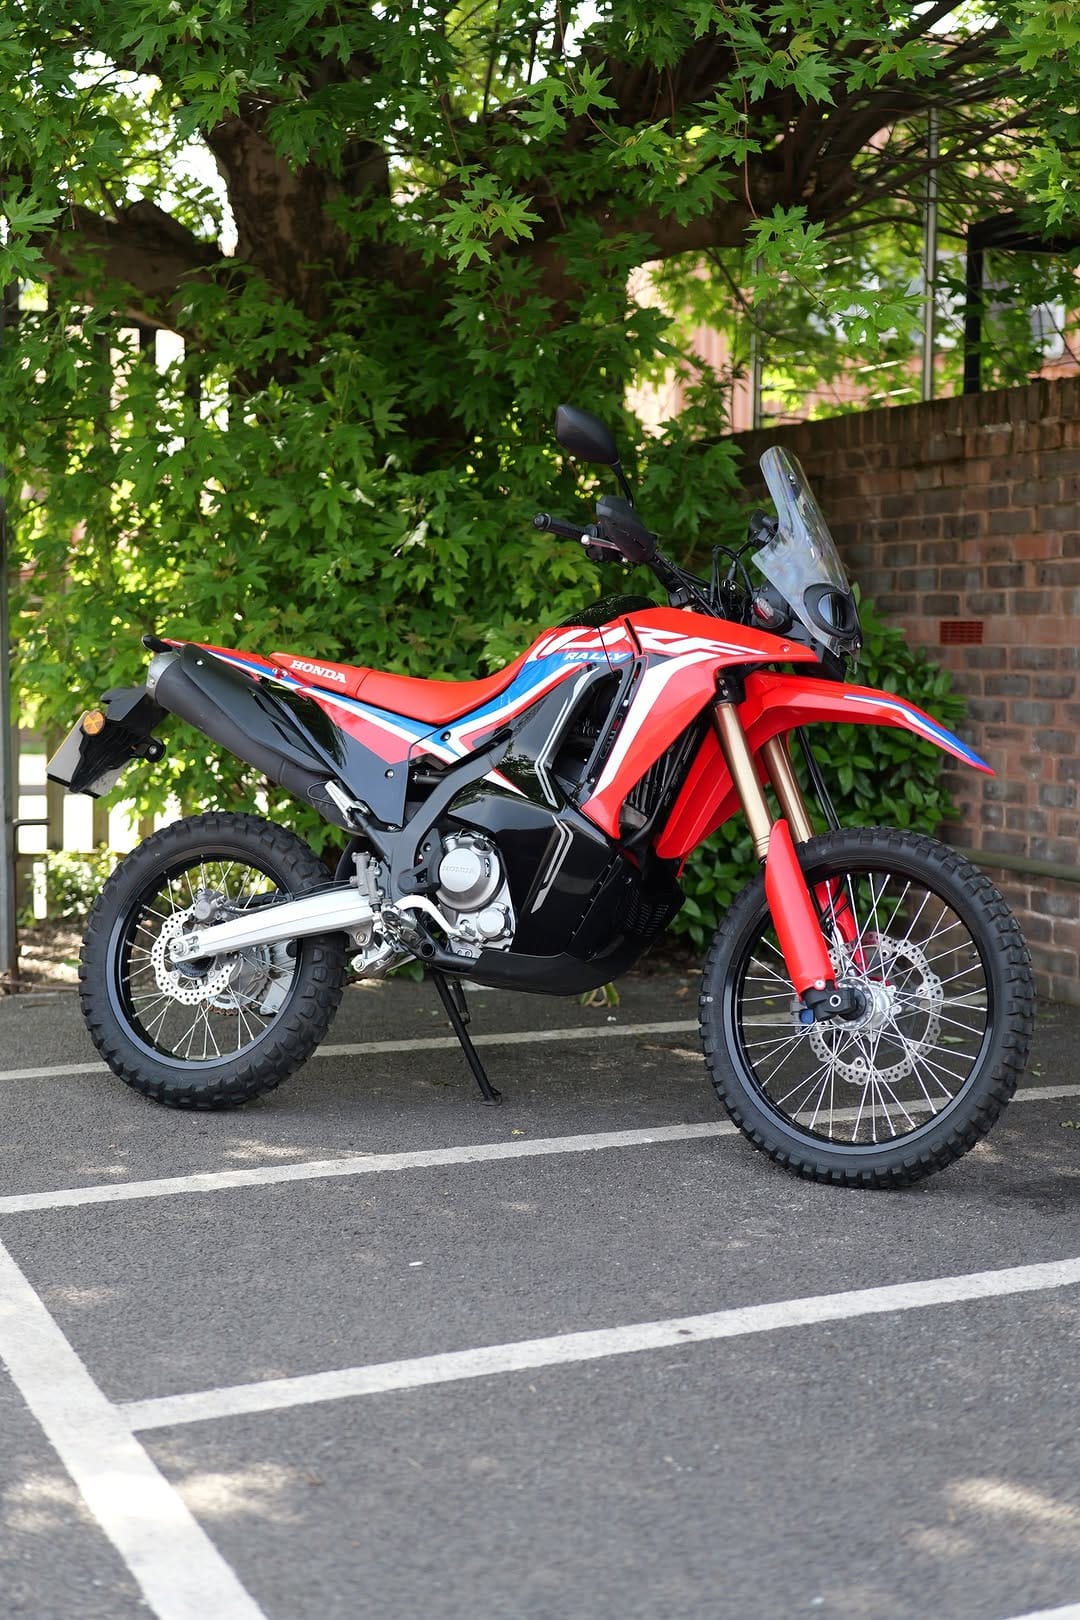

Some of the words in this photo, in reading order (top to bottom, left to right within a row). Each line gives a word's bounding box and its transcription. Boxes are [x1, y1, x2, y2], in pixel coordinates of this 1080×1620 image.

[563, 651, 629, 661] RALLY
[289, 660, 347, 684] HONDA
[442, 864, 474, 875] HONDA
